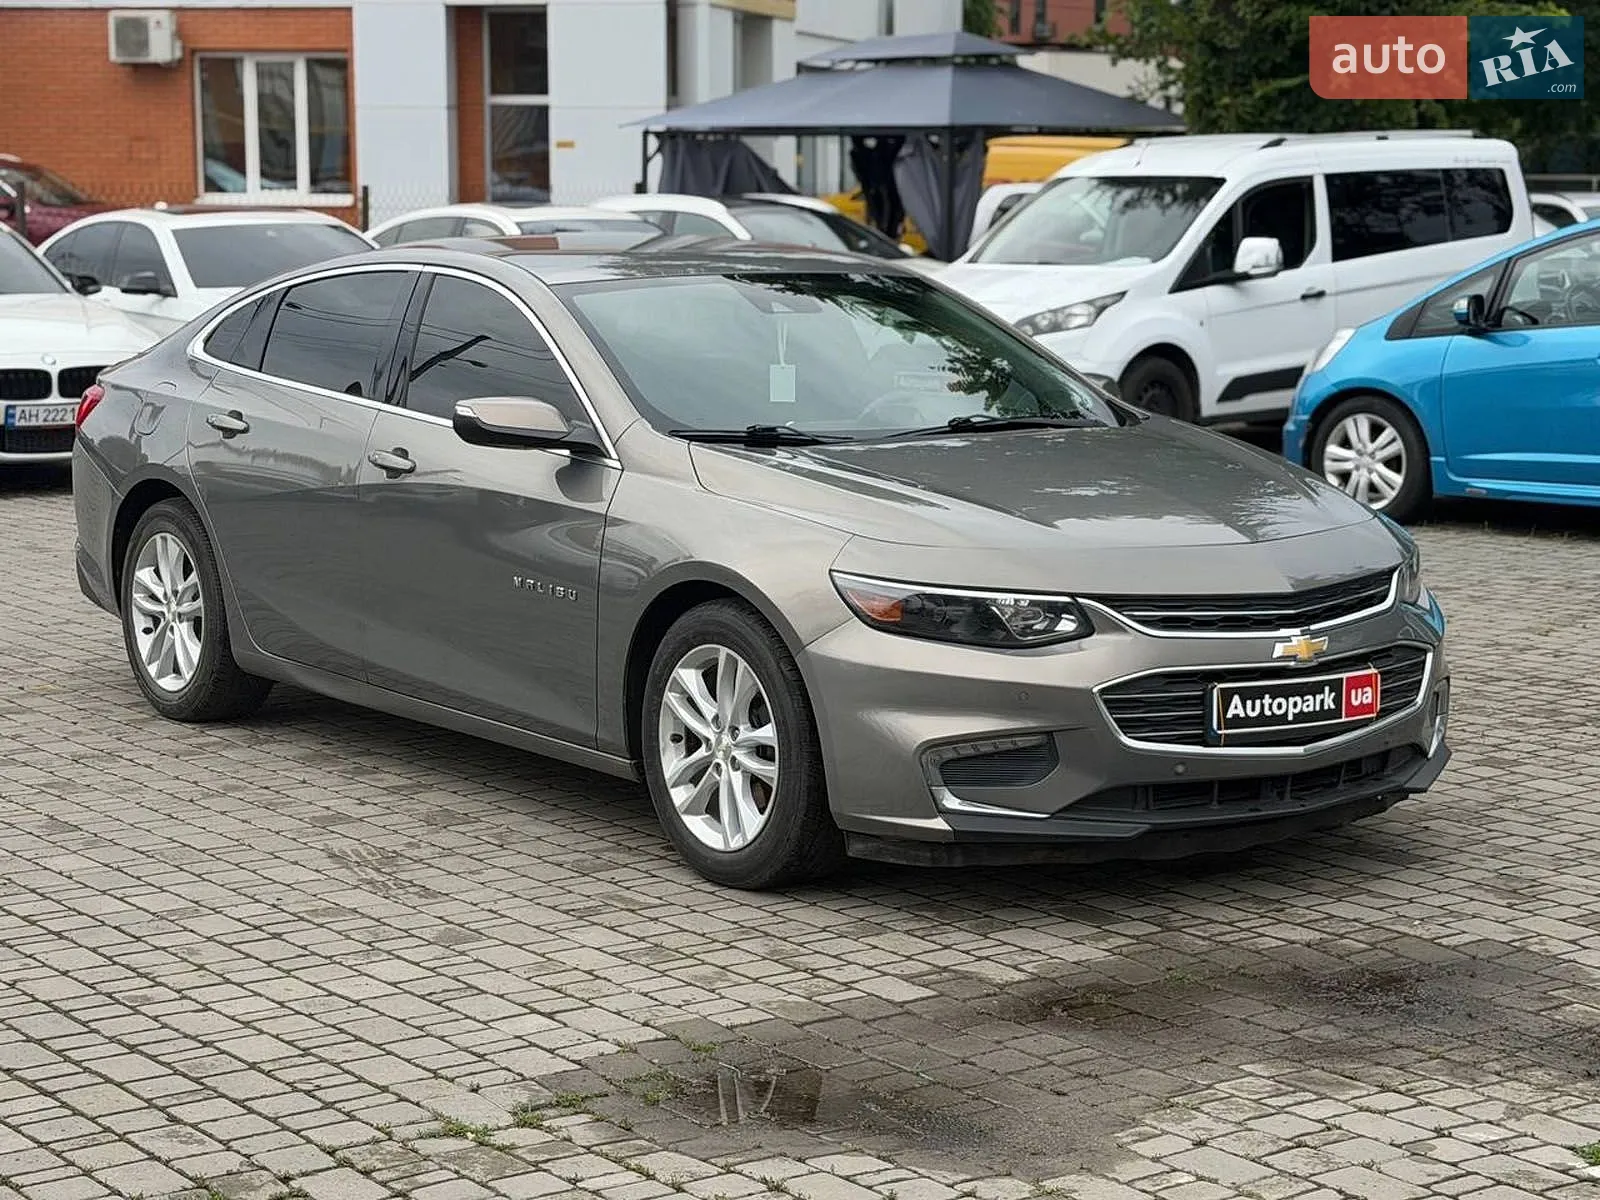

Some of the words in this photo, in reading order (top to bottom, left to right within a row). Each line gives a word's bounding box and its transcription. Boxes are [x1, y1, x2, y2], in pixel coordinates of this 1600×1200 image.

[18, 409, 39, 423] AH
[512, 574, 577, 601] MALIBU
[1225, 686, 1336, 720] Autopark
[1350, 686, 1373, 707] ua
